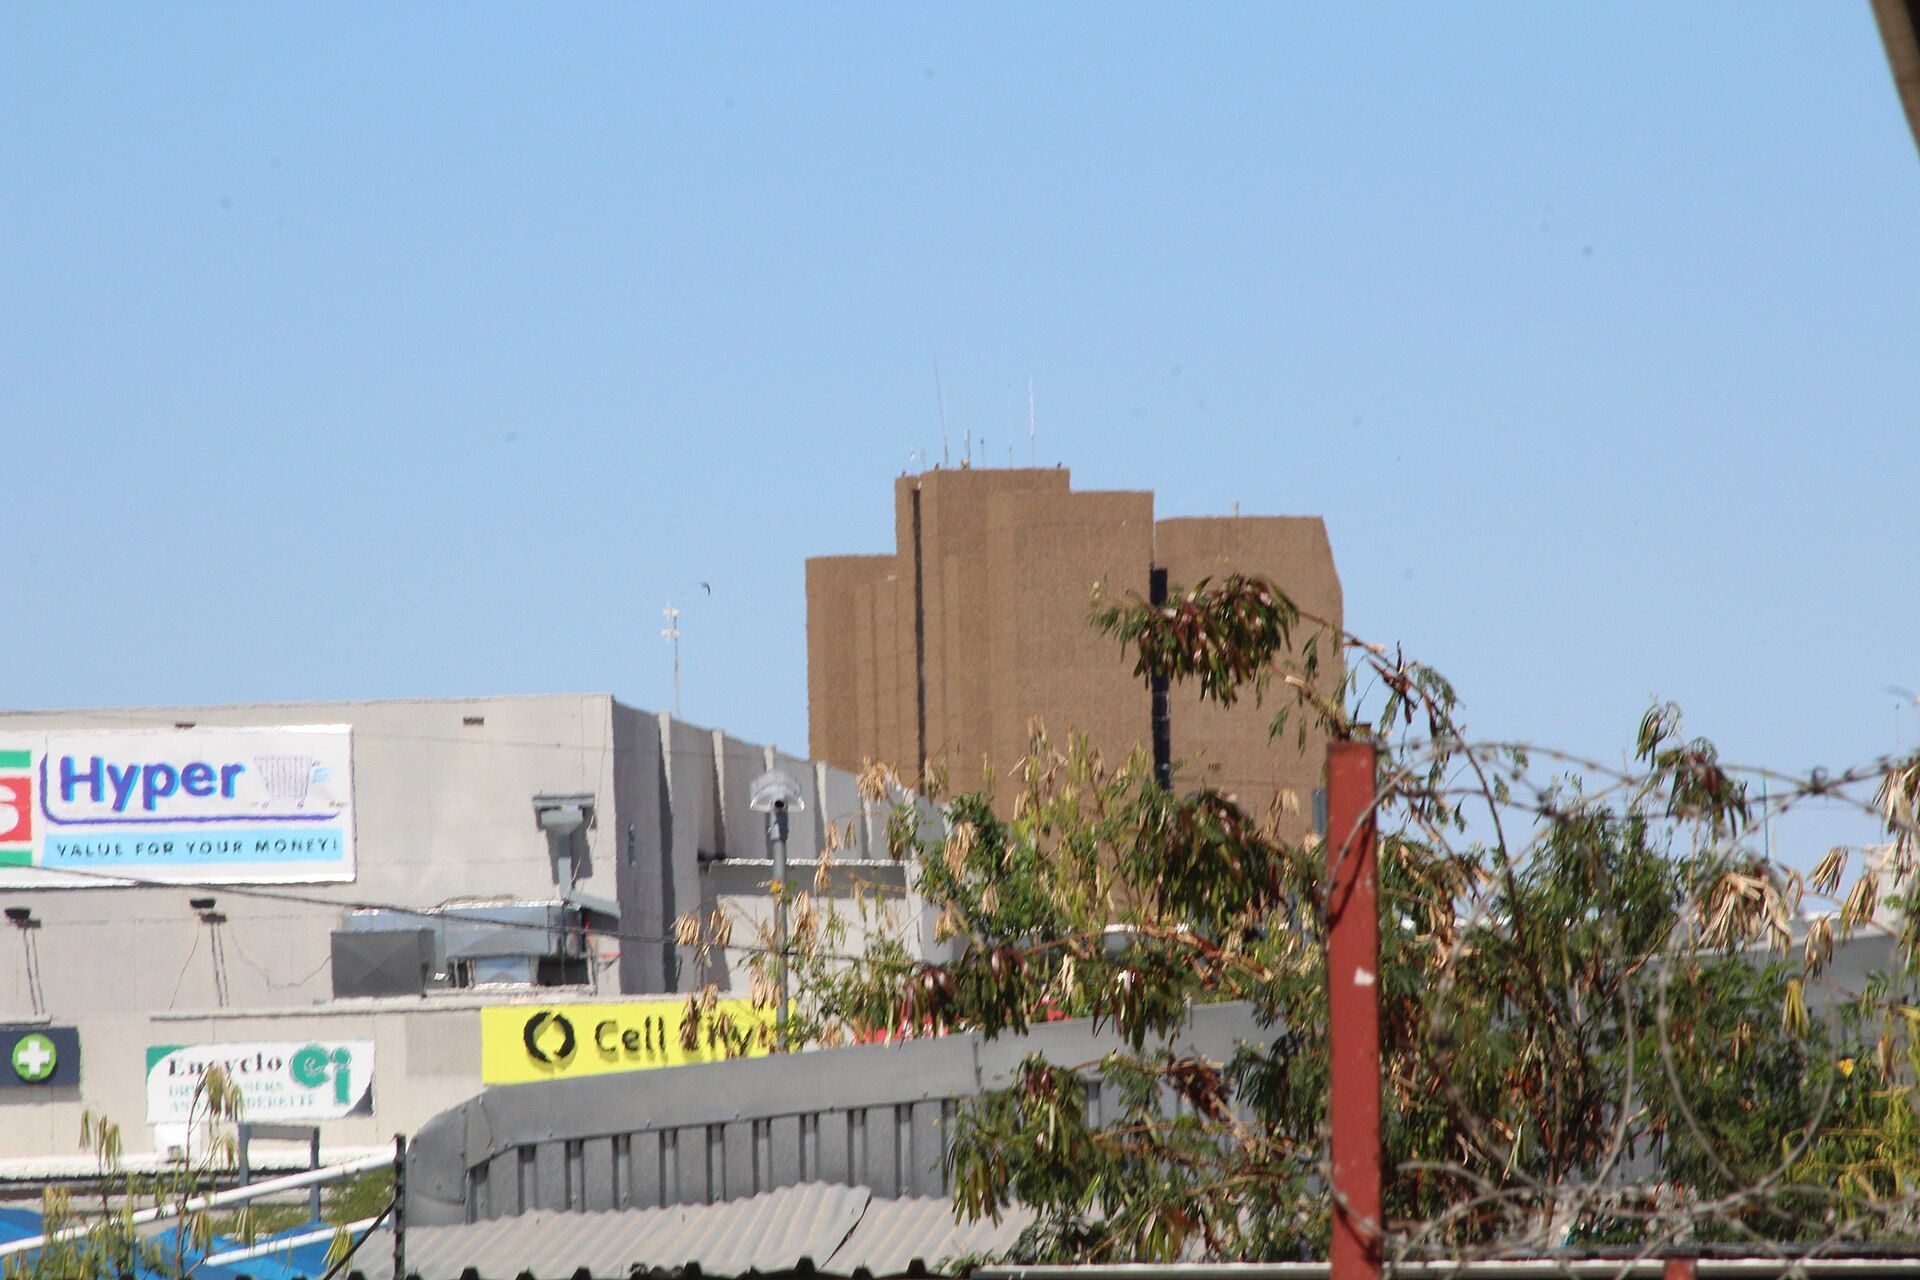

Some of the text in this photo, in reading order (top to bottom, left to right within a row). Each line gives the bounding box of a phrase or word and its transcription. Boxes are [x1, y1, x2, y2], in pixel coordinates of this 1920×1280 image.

[60, 755, 247, 812] Hyper
[56, 842, 123, 857] VALUE
[135, 841, 173, 857] FOR
[186, 839, 241, 856] YOUR
[594, 1014, 666, 1053] Cell
